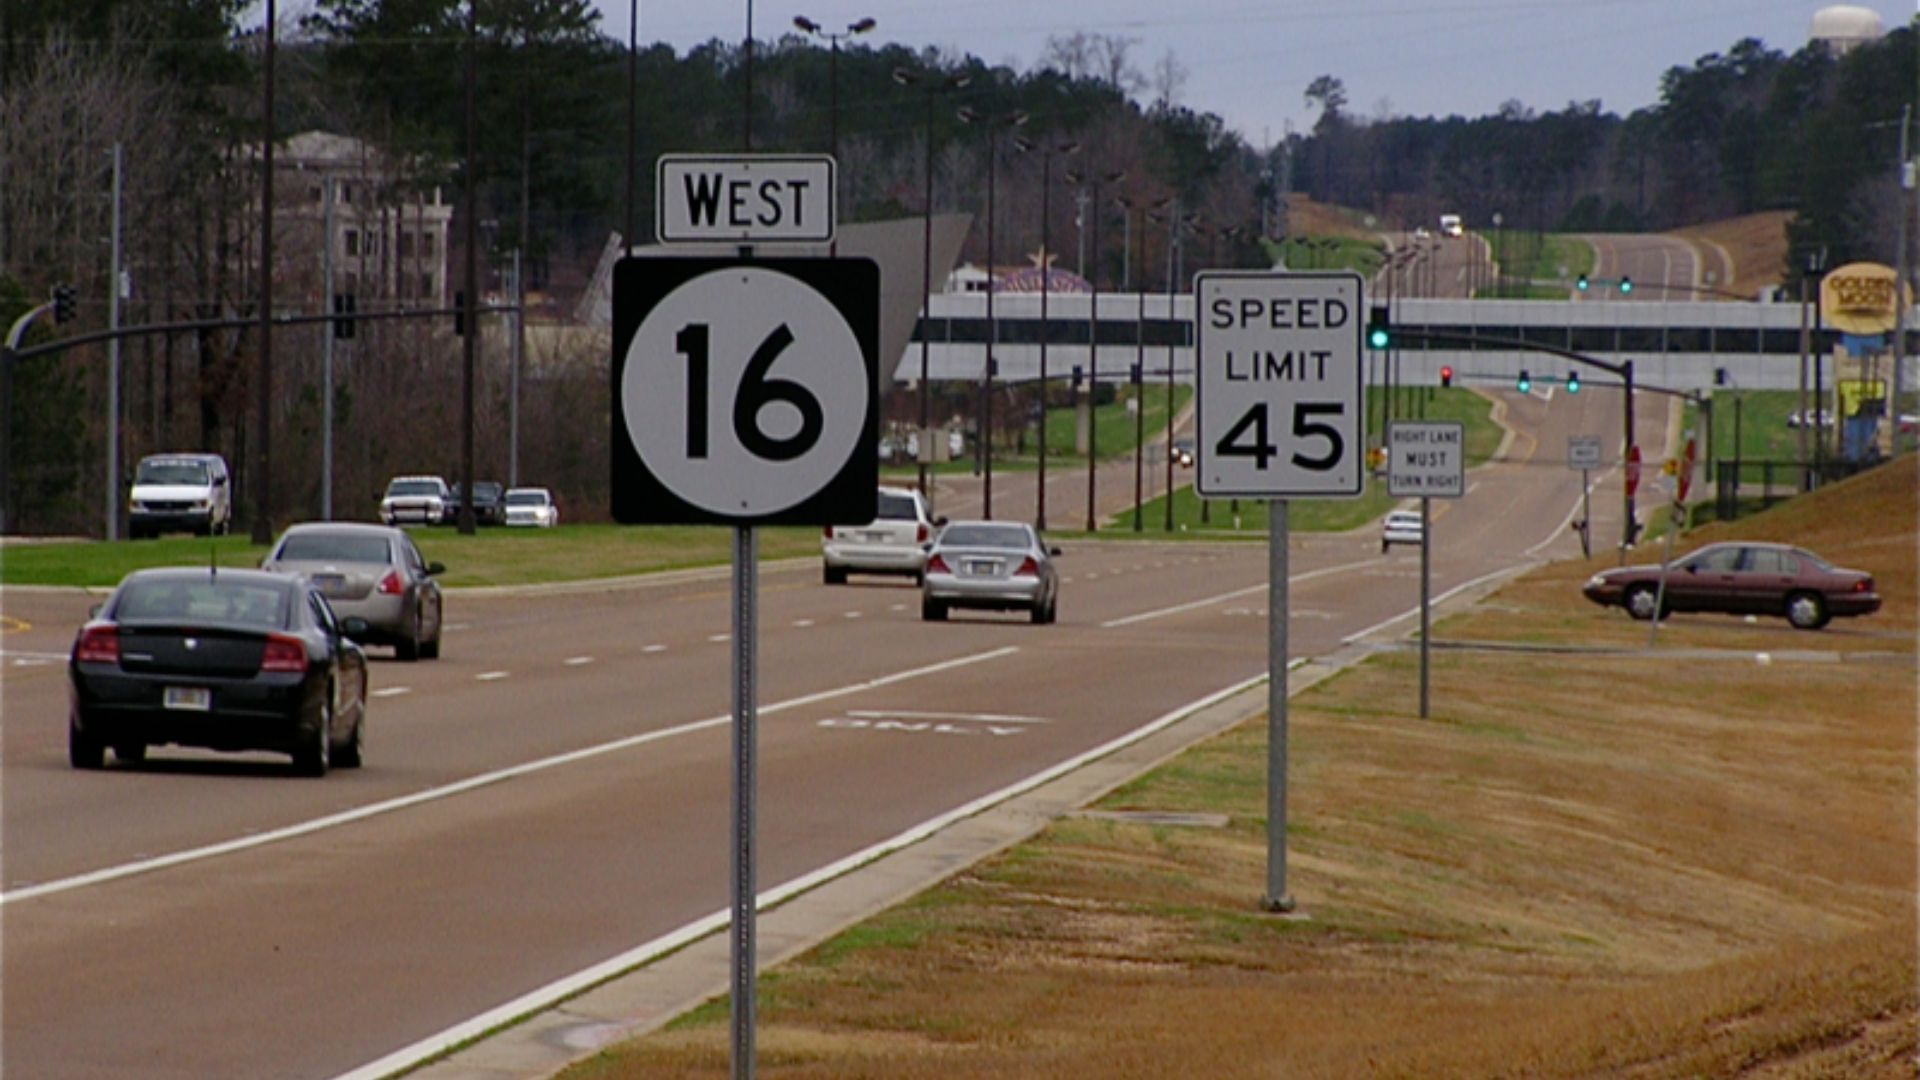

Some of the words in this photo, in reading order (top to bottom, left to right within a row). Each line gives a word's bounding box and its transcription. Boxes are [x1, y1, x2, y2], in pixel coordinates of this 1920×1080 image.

[684, 173, 809, 227] WEST
[1211, 298, 1347, 329] SPEED
[1226, 351, 1331, 381] LIMIT
[676, 322, 824, 461] 16
[1215, 402, 1344, 471] 45
[1394, 431, 1425, 443] RIGHT
[1430, 431, 1457, 443] LANE
[1406, 452, 1446, 467] MUST
[1394, 475, 1421, 487] TURN
[1427, 475, 1458, 487] RIGHT
[817, 719, 1025, 735] ONLY
